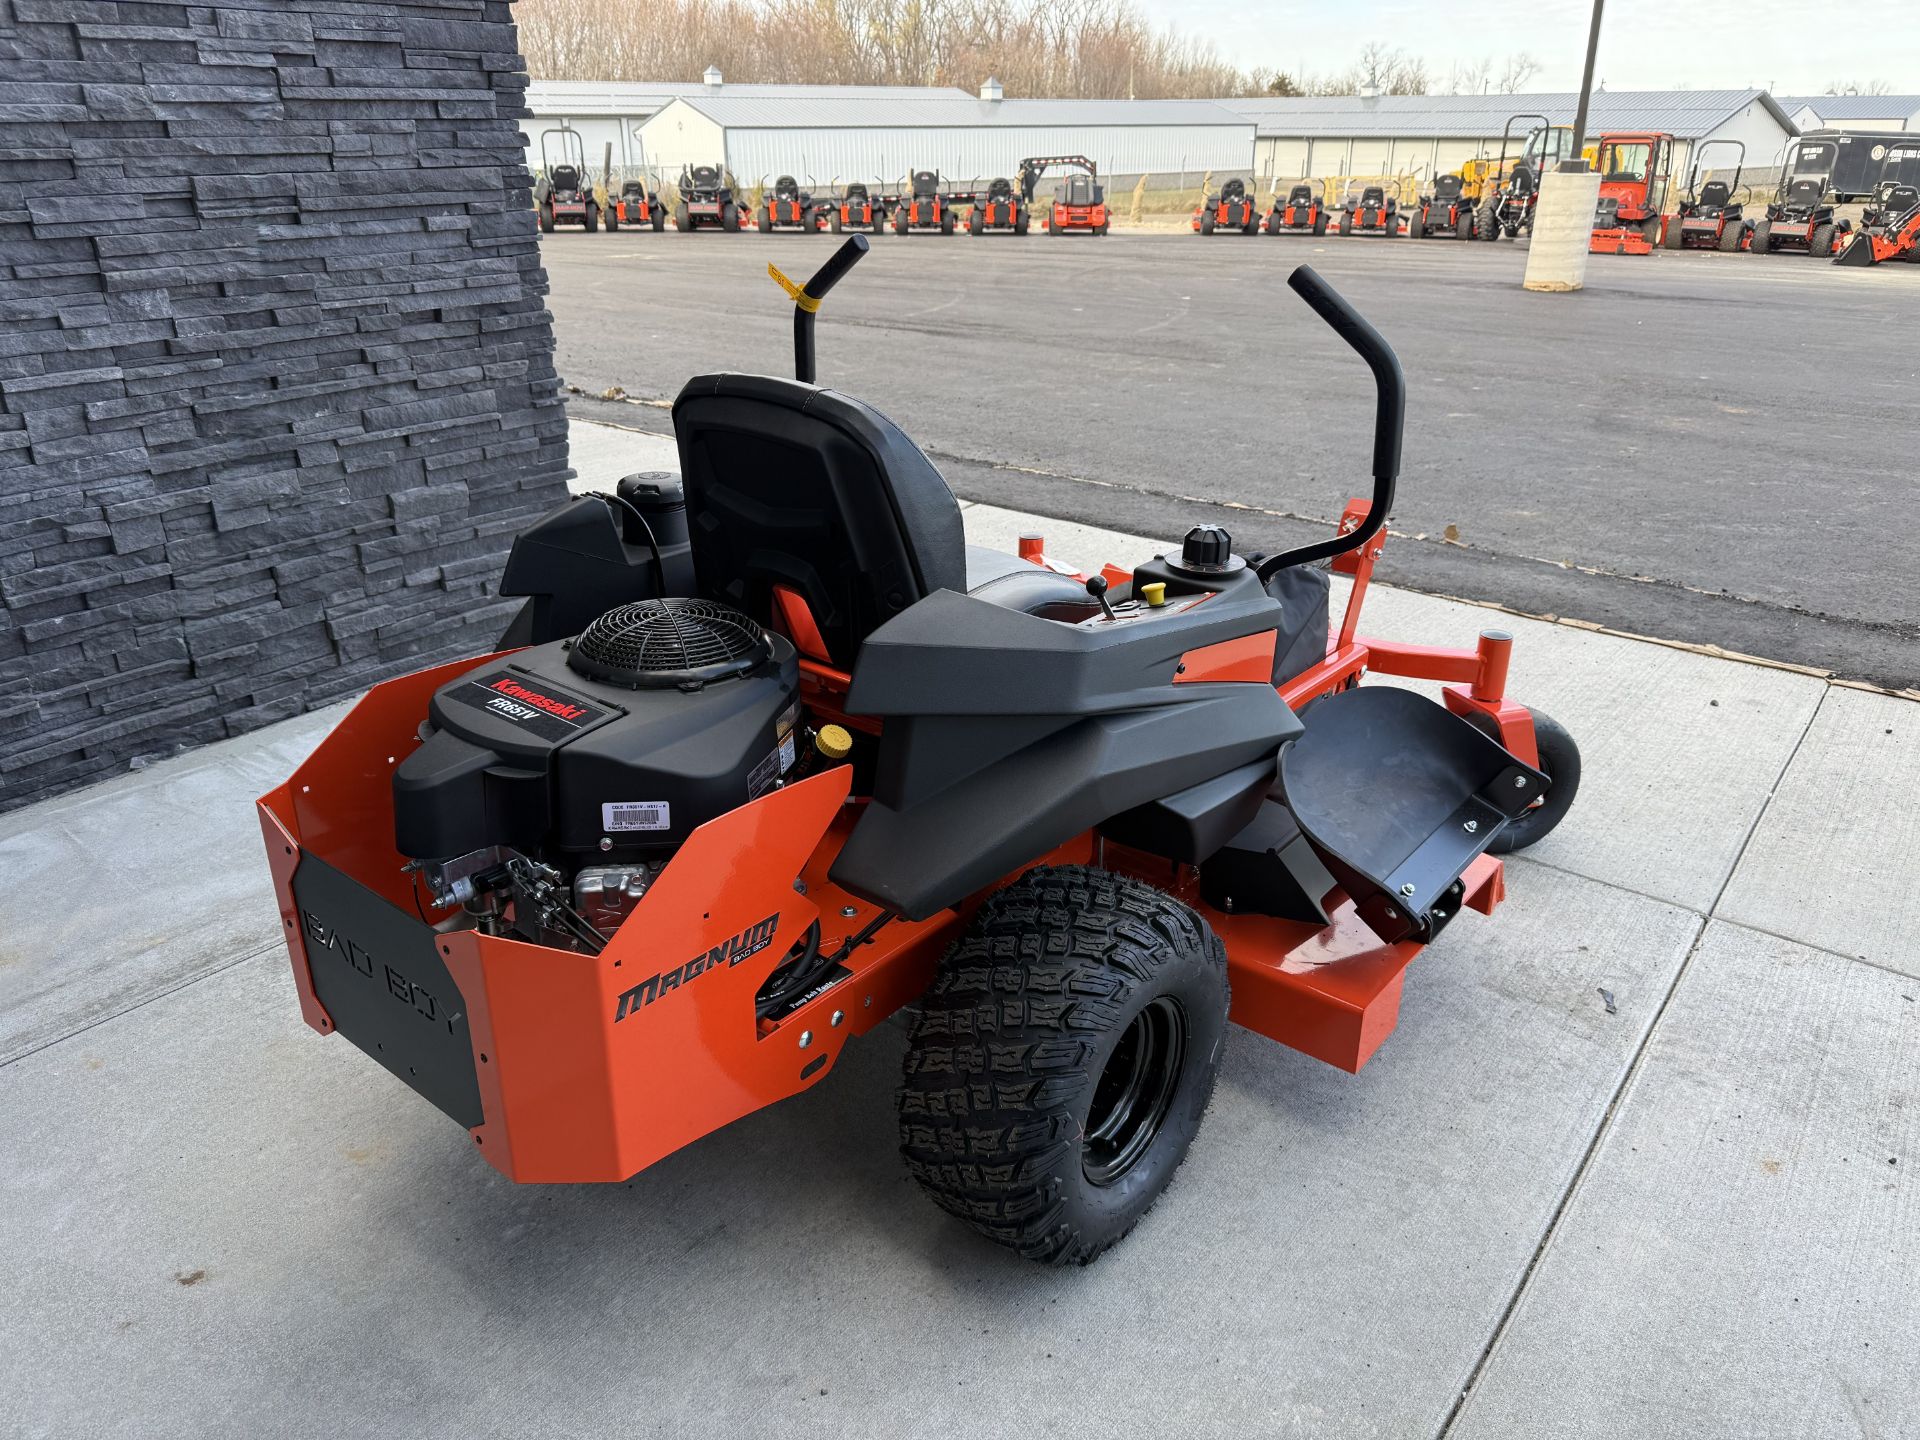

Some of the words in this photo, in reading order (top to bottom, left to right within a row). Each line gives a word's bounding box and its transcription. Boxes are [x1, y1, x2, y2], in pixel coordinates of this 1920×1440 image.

[487, 697, 540, 720] FR651V
[490, 678, 588, 720] Kawasaki
[614, 912, 780, 1023] MAGNUM
[733, 949, 751, 963] BAD
[752, 937, 770, 952] BOY
[303, 909, 374, 979] BAD
[384, 964, 461, 1035] BOY
